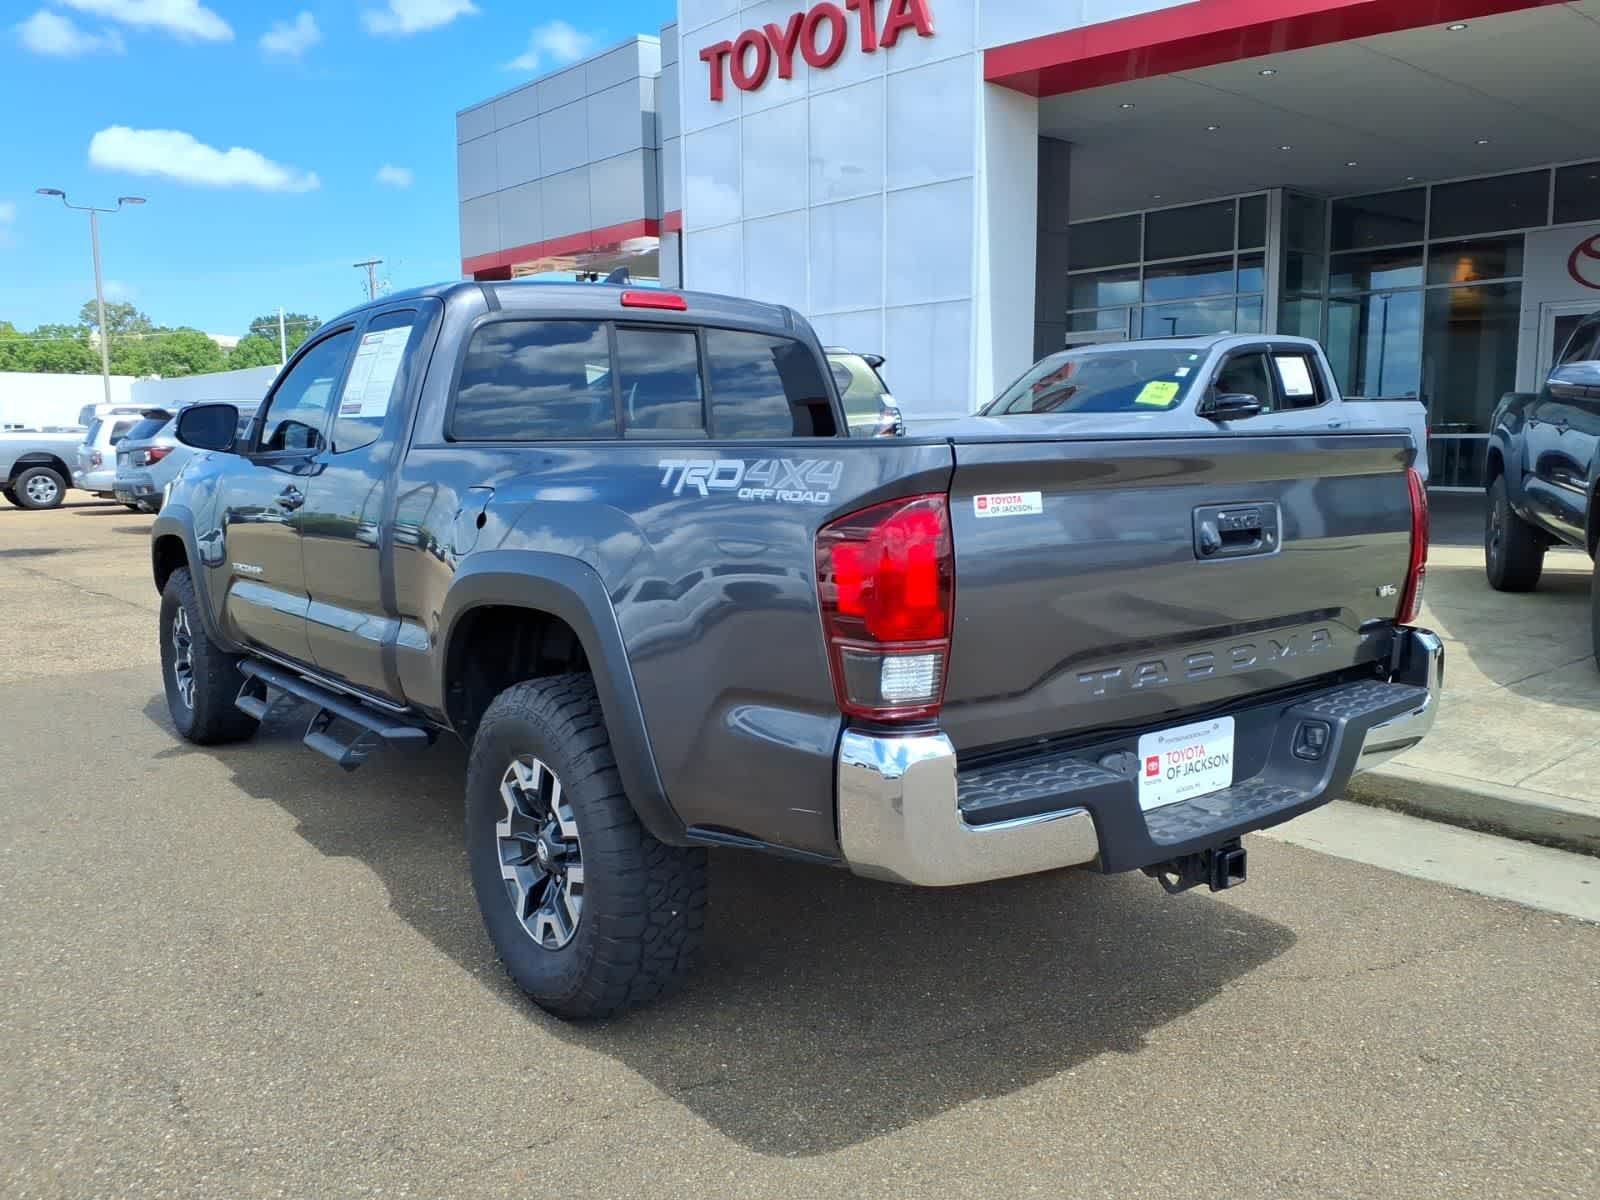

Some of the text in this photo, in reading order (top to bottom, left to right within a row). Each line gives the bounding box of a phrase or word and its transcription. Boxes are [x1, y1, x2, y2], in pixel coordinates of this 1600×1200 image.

[699, 0, 935, 102] TOYOTA
[658, 458, 746, 497] TRD
[738, 487, 831, 504] OFF ROAD
[990, 495, 1023, 505] TOYOTA
[990, 504, 1033, 514] OF JACKSON
[1076, 627, 1334, 696] TACOMA
[1166, 744, 1206, 764] TOYOTA
[1166, 752, 1230, 780] OF JACKSON
